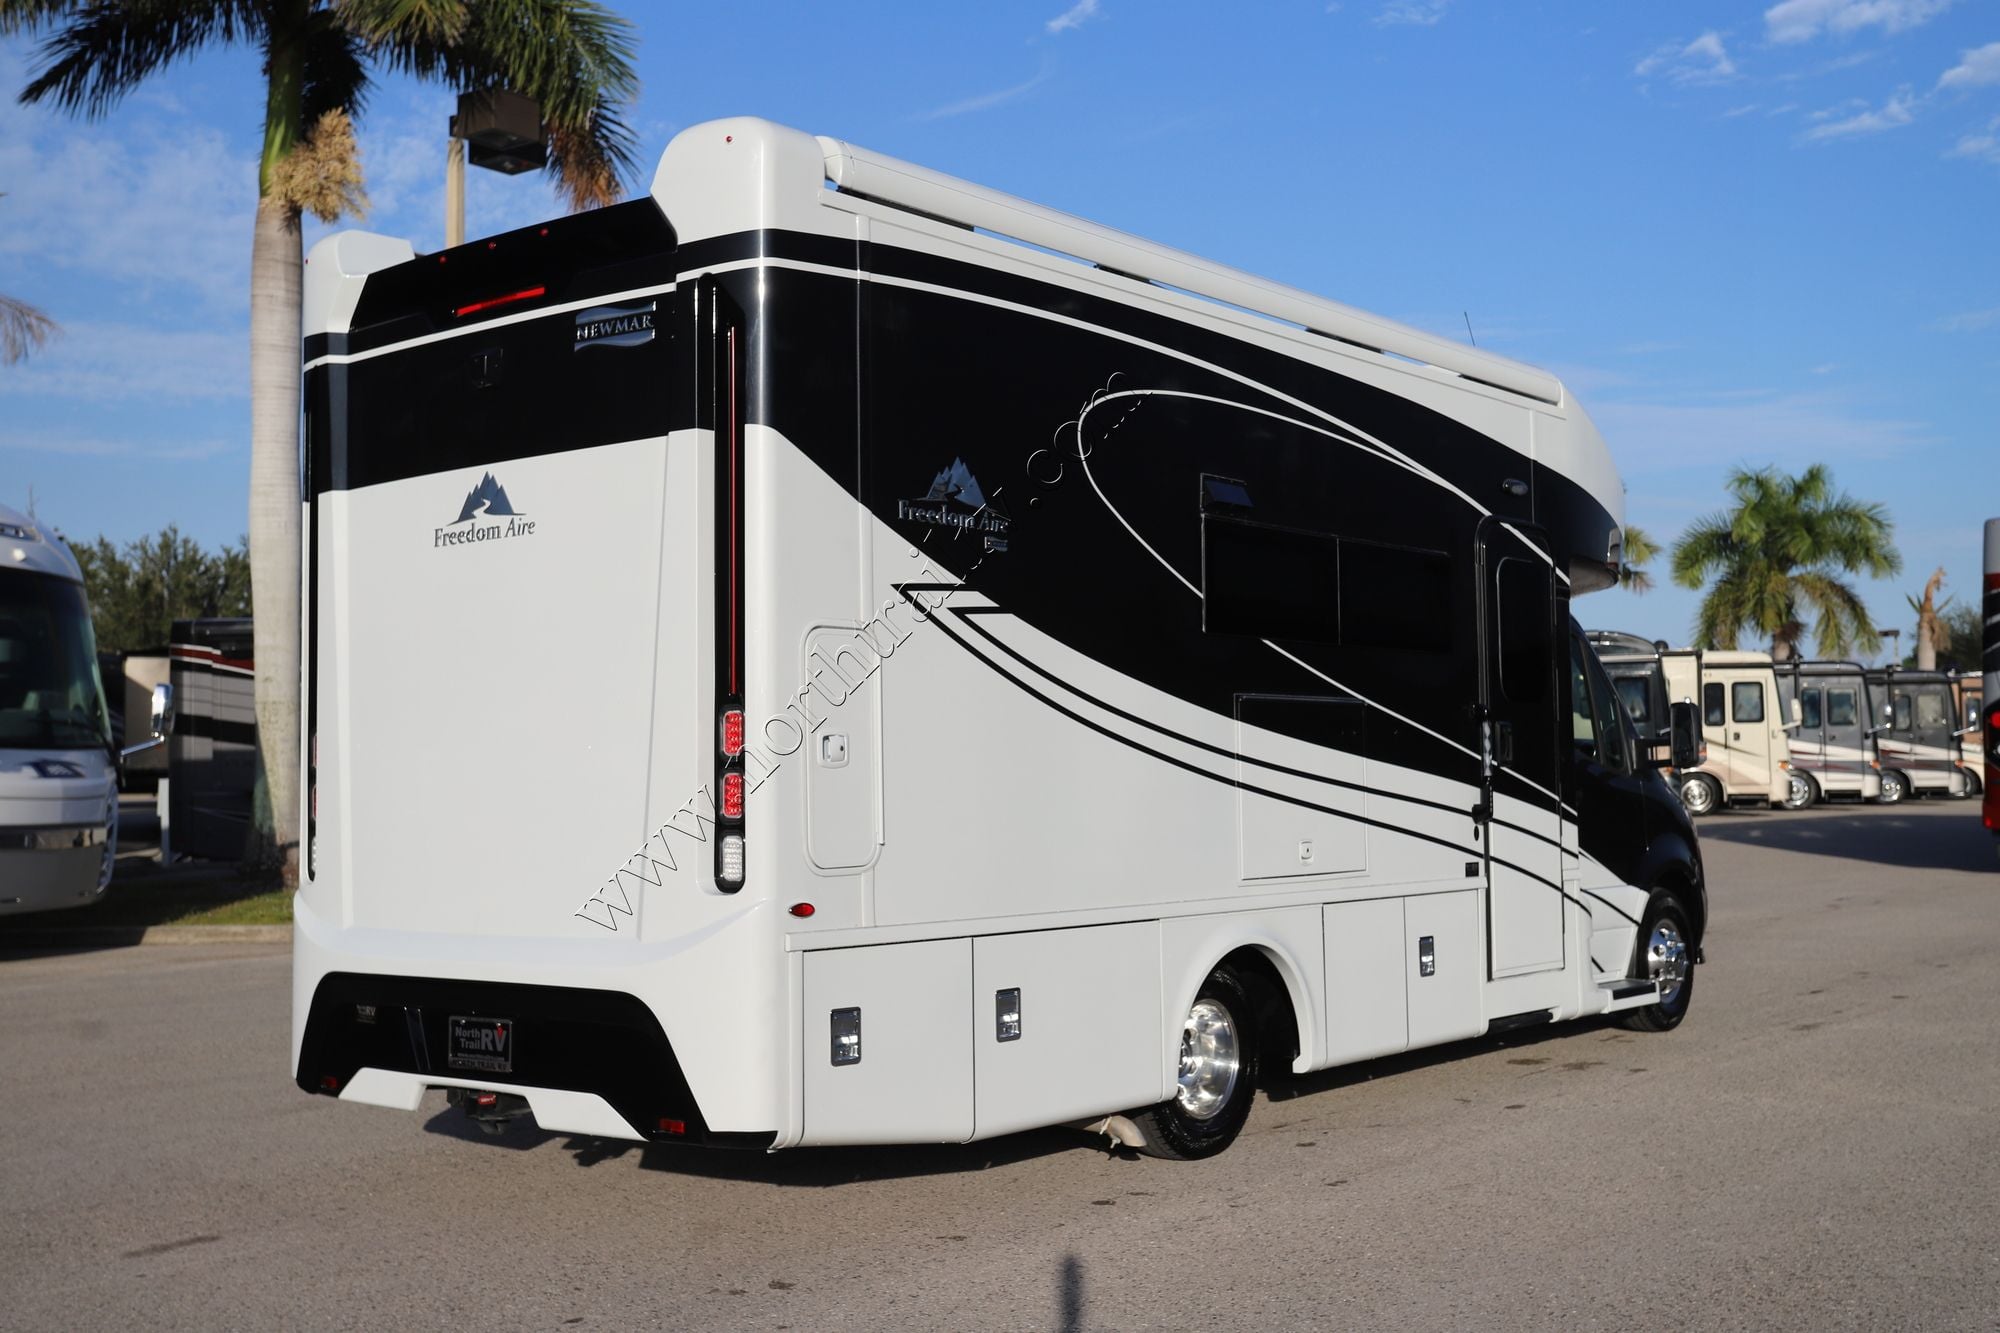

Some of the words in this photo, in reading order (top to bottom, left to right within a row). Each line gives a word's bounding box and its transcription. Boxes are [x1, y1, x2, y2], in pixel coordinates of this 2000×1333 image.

[576, 314, 654, 340] NEWMAR
[897, 498, 975, 528] Freedom
[434, 522, 502, 548] Freedom
[504, 517, 536, 539] Aire
[455, 1026, 481, 1039] North
[459, 1038, 481, 1050] Trail
[480, 1028, 507, 1053] RV
